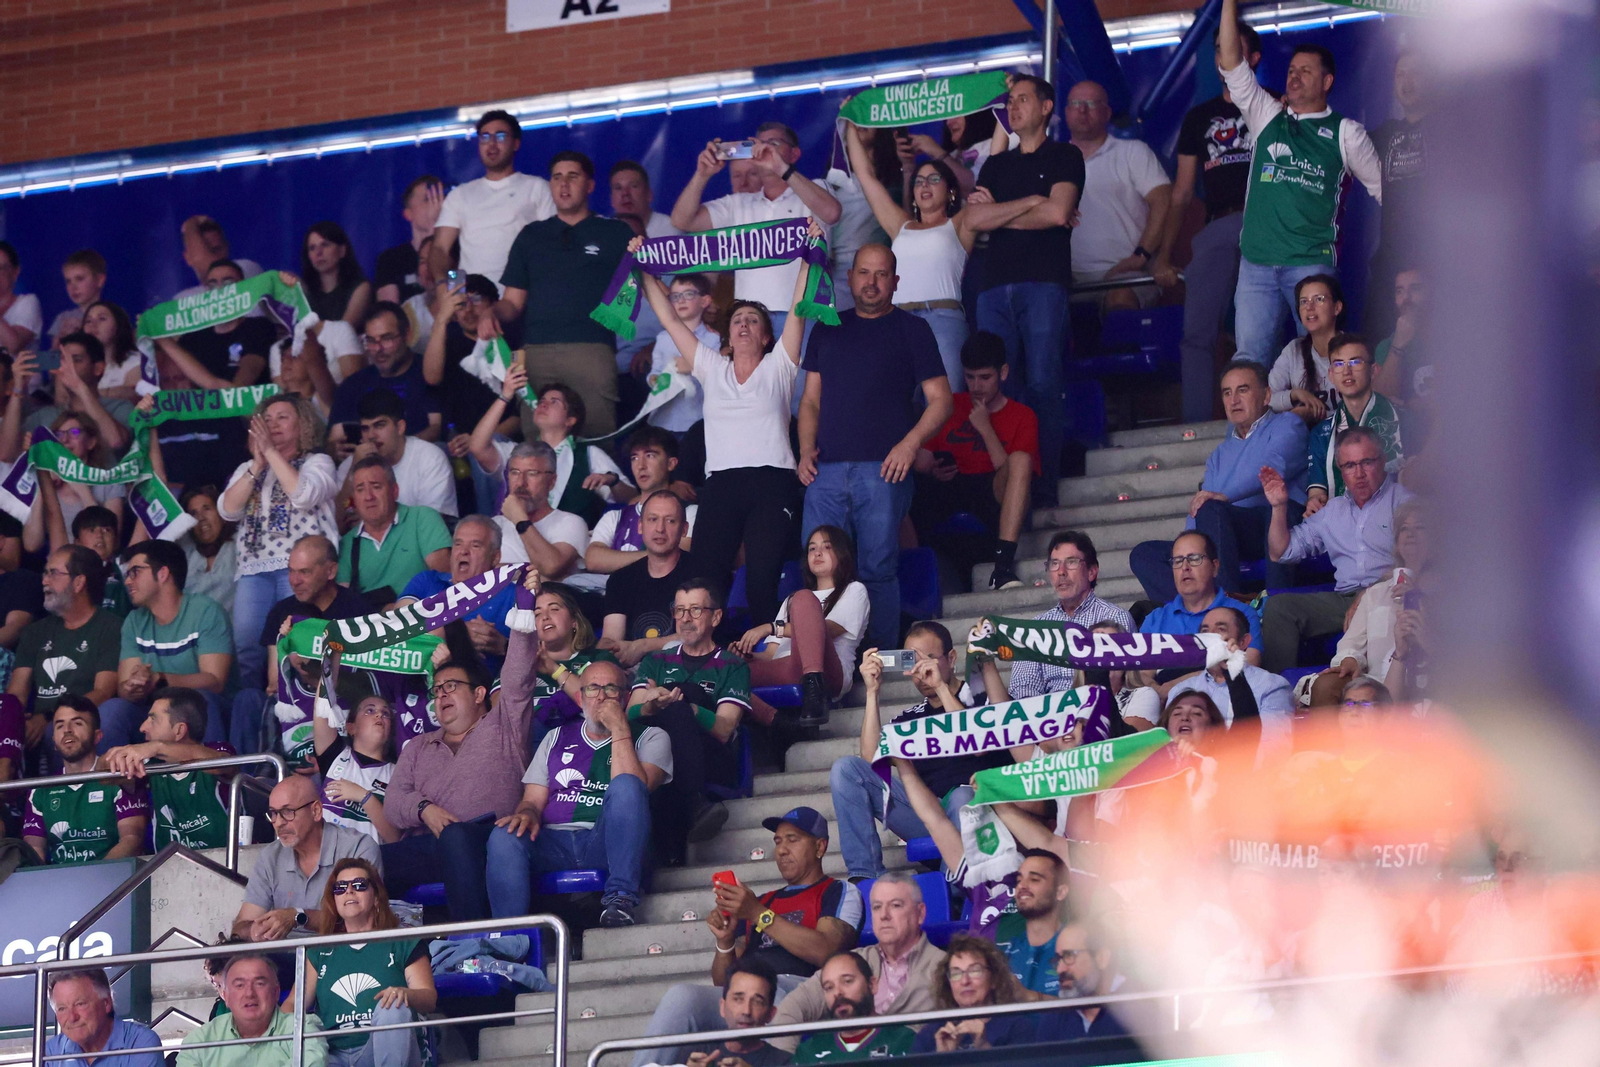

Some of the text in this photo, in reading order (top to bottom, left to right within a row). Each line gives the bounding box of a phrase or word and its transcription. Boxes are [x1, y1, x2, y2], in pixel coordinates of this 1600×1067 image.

[885, 79, 950, 103] UNICAJA
[870, 94, 963, 122] BALONCESTO
[636, 233, 712, 266] UNICAJA
[165, 291, 251, 331] BALONCESTO
[178, 283, 237, 311] UNICAJA
[336, 562, 525, 644] UNICAJA
[383, 593, 492, 643] BALONCESTO
[312, 636, 422, 670] BONCESTO
[998, 623, 1184, 659] UNICAJA
[38, 684, 68, 698] Unicaja
[893, 687, 1082, 737] UNICAJA
[1000, 742, 1114, 776] BALONCESTO
[1020, 766, 1099, 796] UNICAJA
[68, 827, 107, 839] Unicaja
[1229, 839, 1303, 868] UNICAJA
